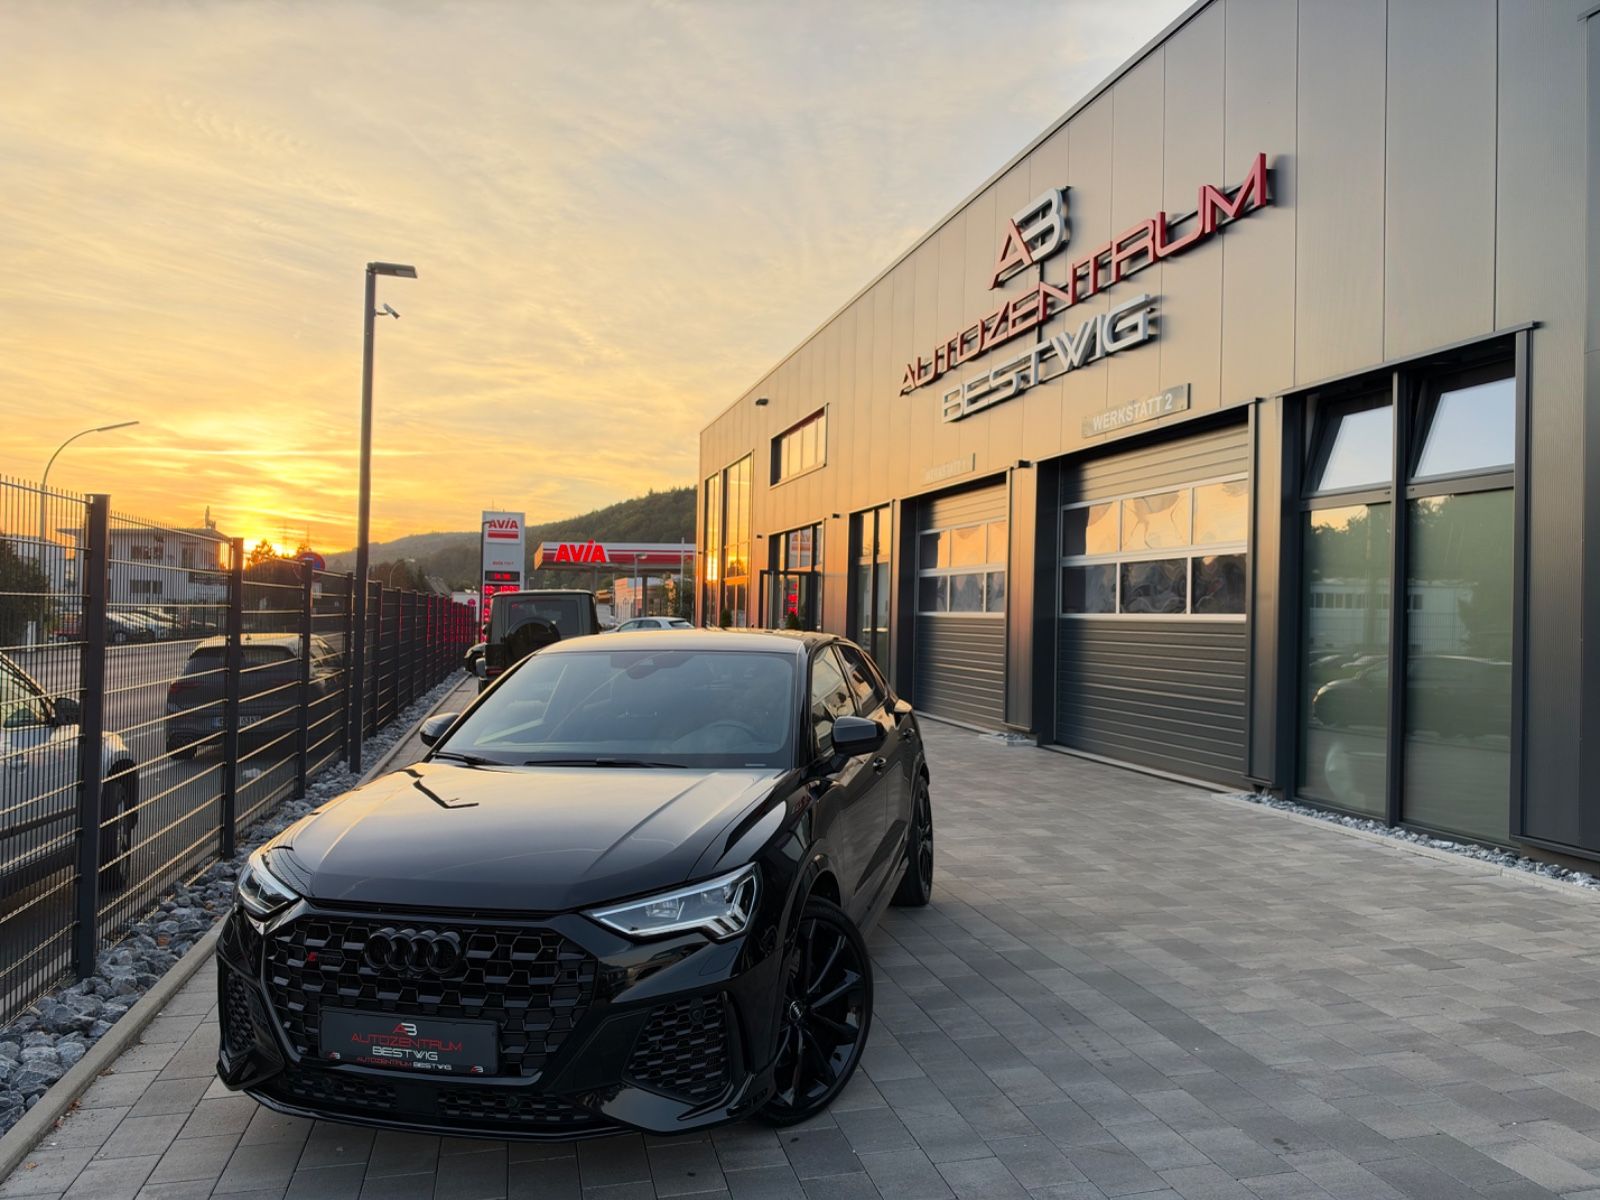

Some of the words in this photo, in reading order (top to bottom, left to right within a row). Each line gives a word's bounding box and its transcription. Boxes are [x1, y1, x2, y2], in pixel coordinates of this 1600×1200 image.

[899, 152, 1268, 396] AUTOZENTRUM
[942, 294, 1151, 423] BESTWIG
[1092, 396, 1162, 431] WERKSTATT
[1164, 393, 1174, 411] 2
[556, 540, 608, 562] AVIA
[351, 1033, 464, 1052] AUTOZENTRUM
[372, 1045, 439, 1061] BESTWIG
